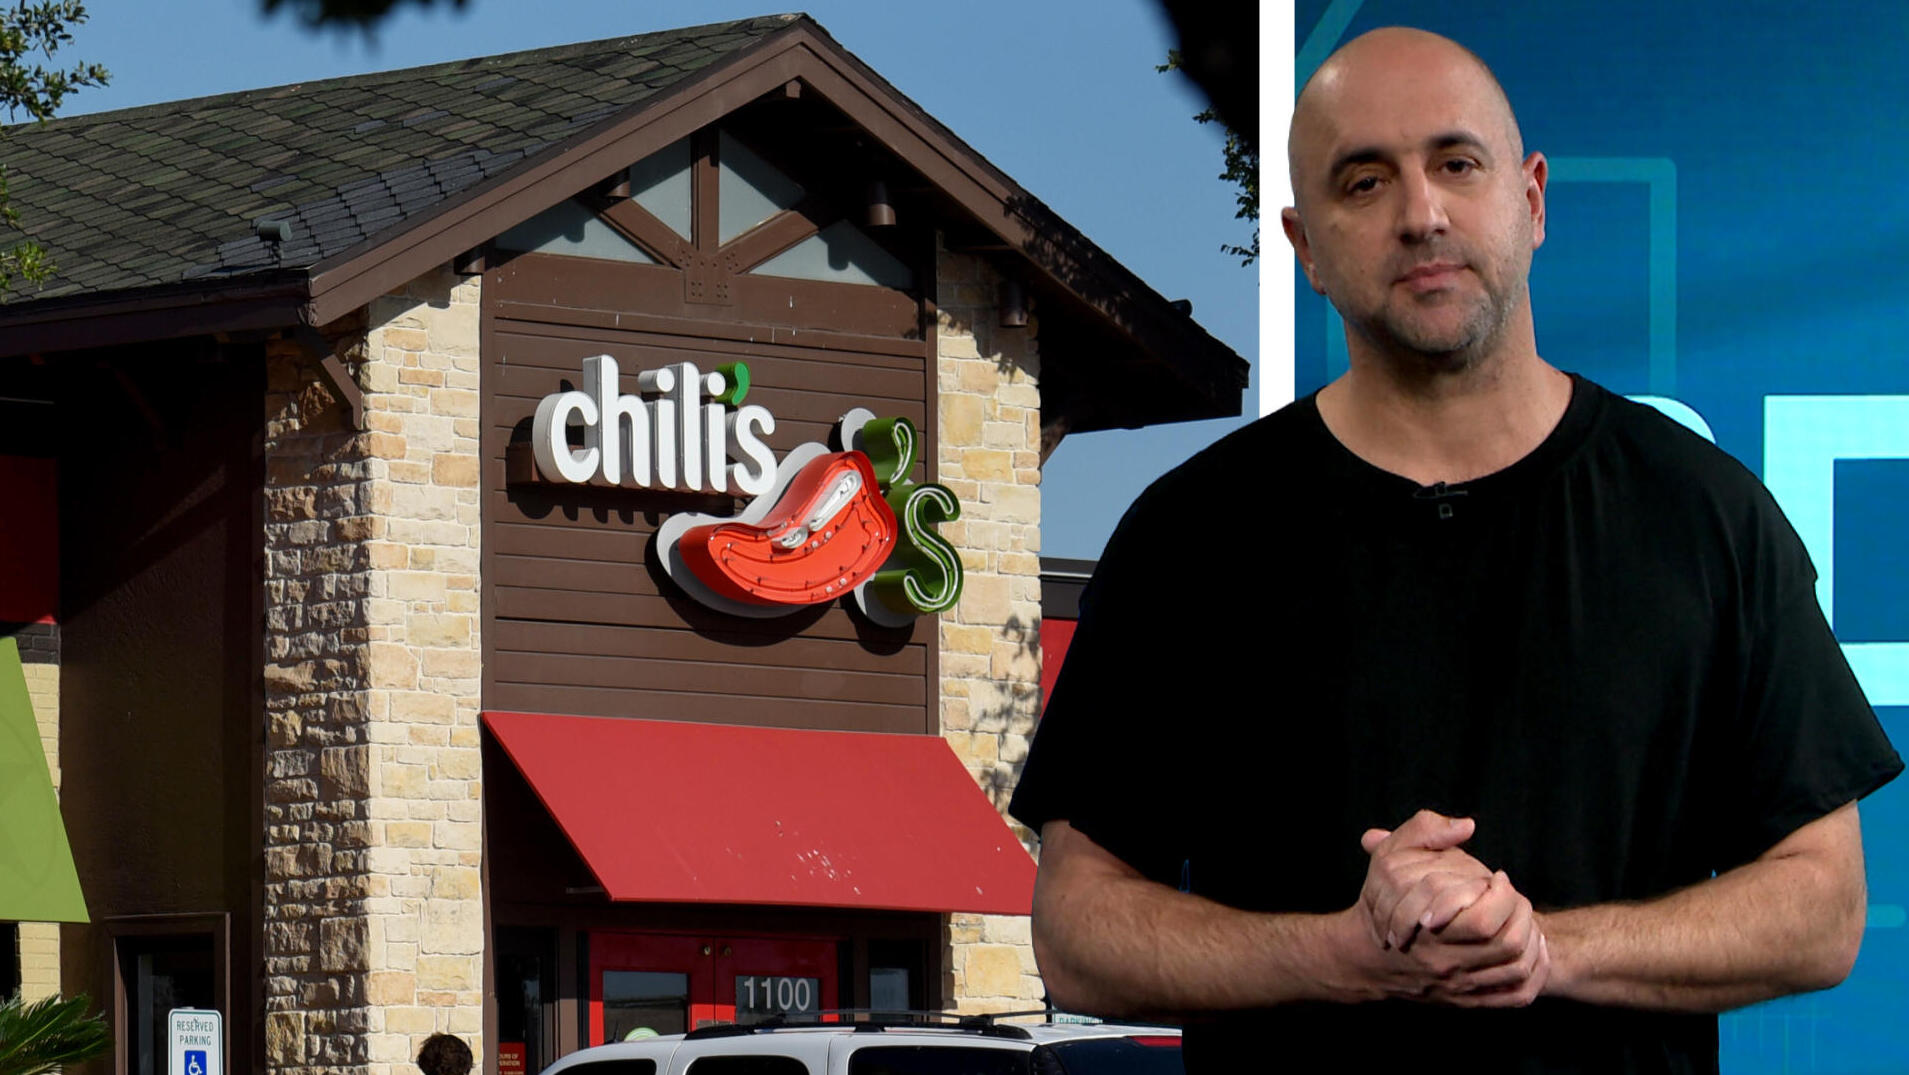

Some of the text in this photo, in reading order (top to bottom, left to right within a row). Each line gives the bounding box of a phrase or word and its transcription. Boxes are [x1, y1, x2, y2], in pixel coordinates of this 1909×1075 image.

[532, 354, 777, 495] chili's
[744, 976, 811, 1012] 1100
[176, 1020, 214, 1032] RESERVED
[179, 1035, 212, 1046] PARKING
